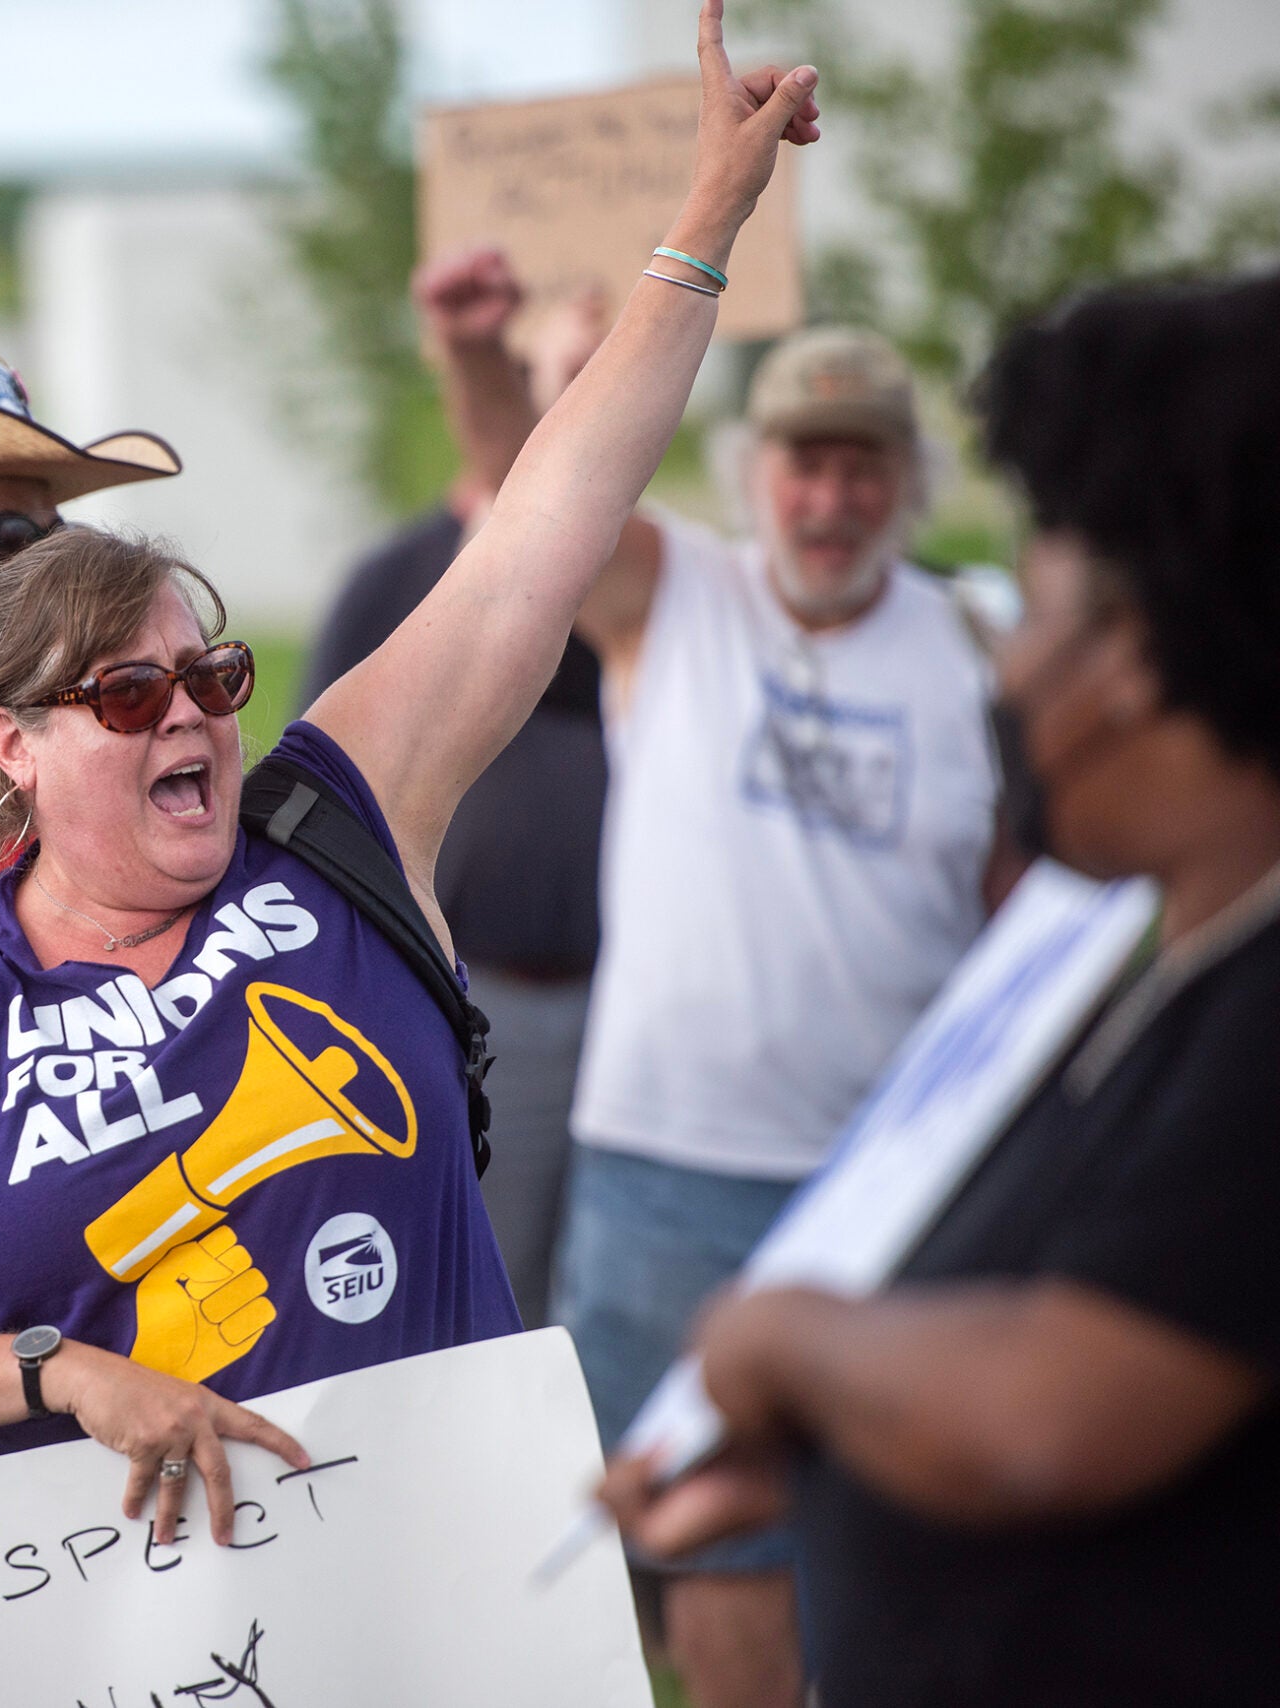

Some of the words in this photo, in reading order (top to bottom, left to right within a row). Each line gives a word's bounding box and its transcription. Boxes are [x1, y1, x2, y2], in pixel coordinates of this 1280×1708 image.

[7, 881, 319, 1059] UNIONS
[1, 1050, 147, 1112] FOR
[8, 1065, 203, 1185] ALL
[326, 1266, 384, 1304] SEIU
